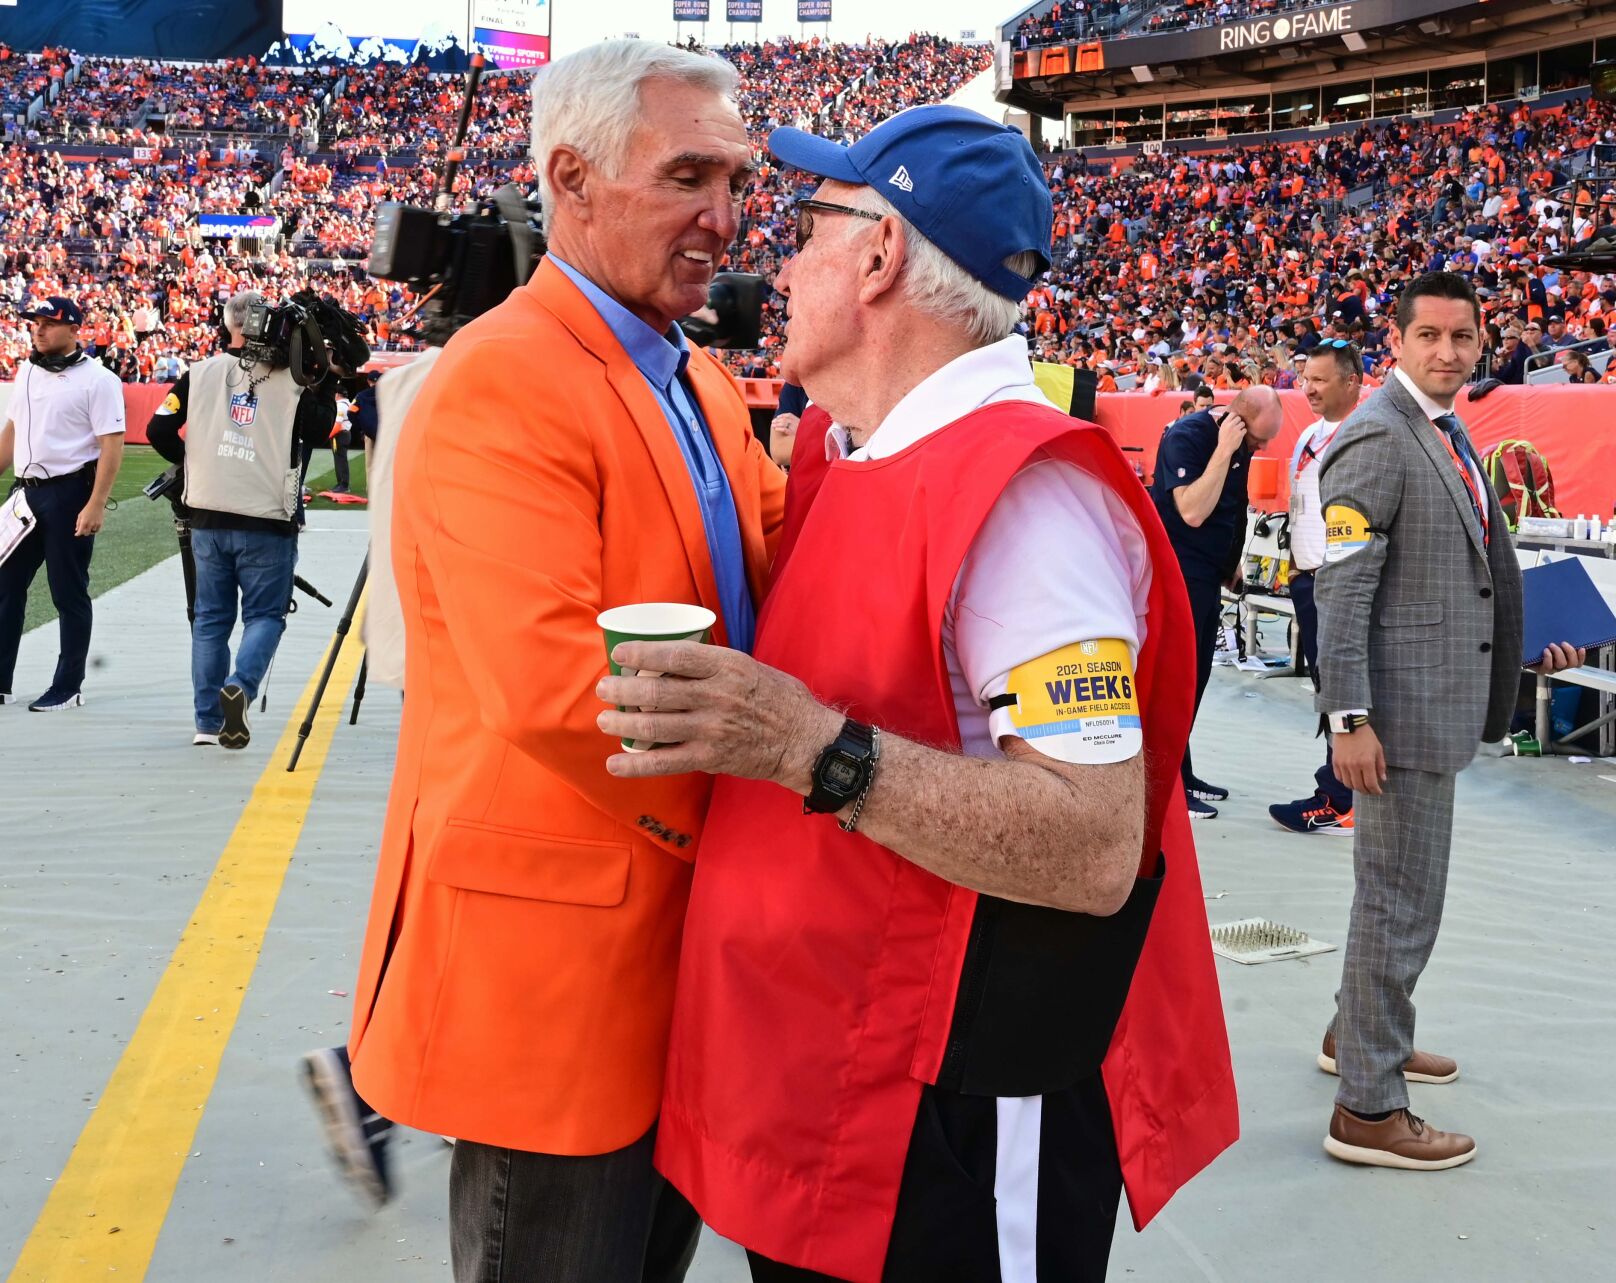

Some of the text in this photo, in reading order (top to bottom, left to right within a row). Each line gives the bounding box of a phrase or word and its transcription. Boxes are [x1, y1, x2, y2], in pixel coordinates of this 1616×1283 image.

[674, 1, 709, 9] SUPER BOWL
[727, 1, 744, 9] SUPER
[798, 1, 832, 9] SUPER BOWL
[675, 8, 708, 16] CHAMPIONS
[799, 8, 830, 16] CHAMPIONS
[1220, 22, 1270, 50] RING
[1292, 6, 1352, 38] FAME
[231, 405, 252, 423] NFL
[223, 430, 254, 448] MEDIA
[1345, 525, 1352, 535] 6
[1056, 661, 1122, 677] 2021 SEASON
[1045, 675, 1132, 705] WEEK 6
[1056, 702, 1131, 716] IN-GAME FIELD ACCESS
[1093, 733, 1123, 741] MCCLURE
